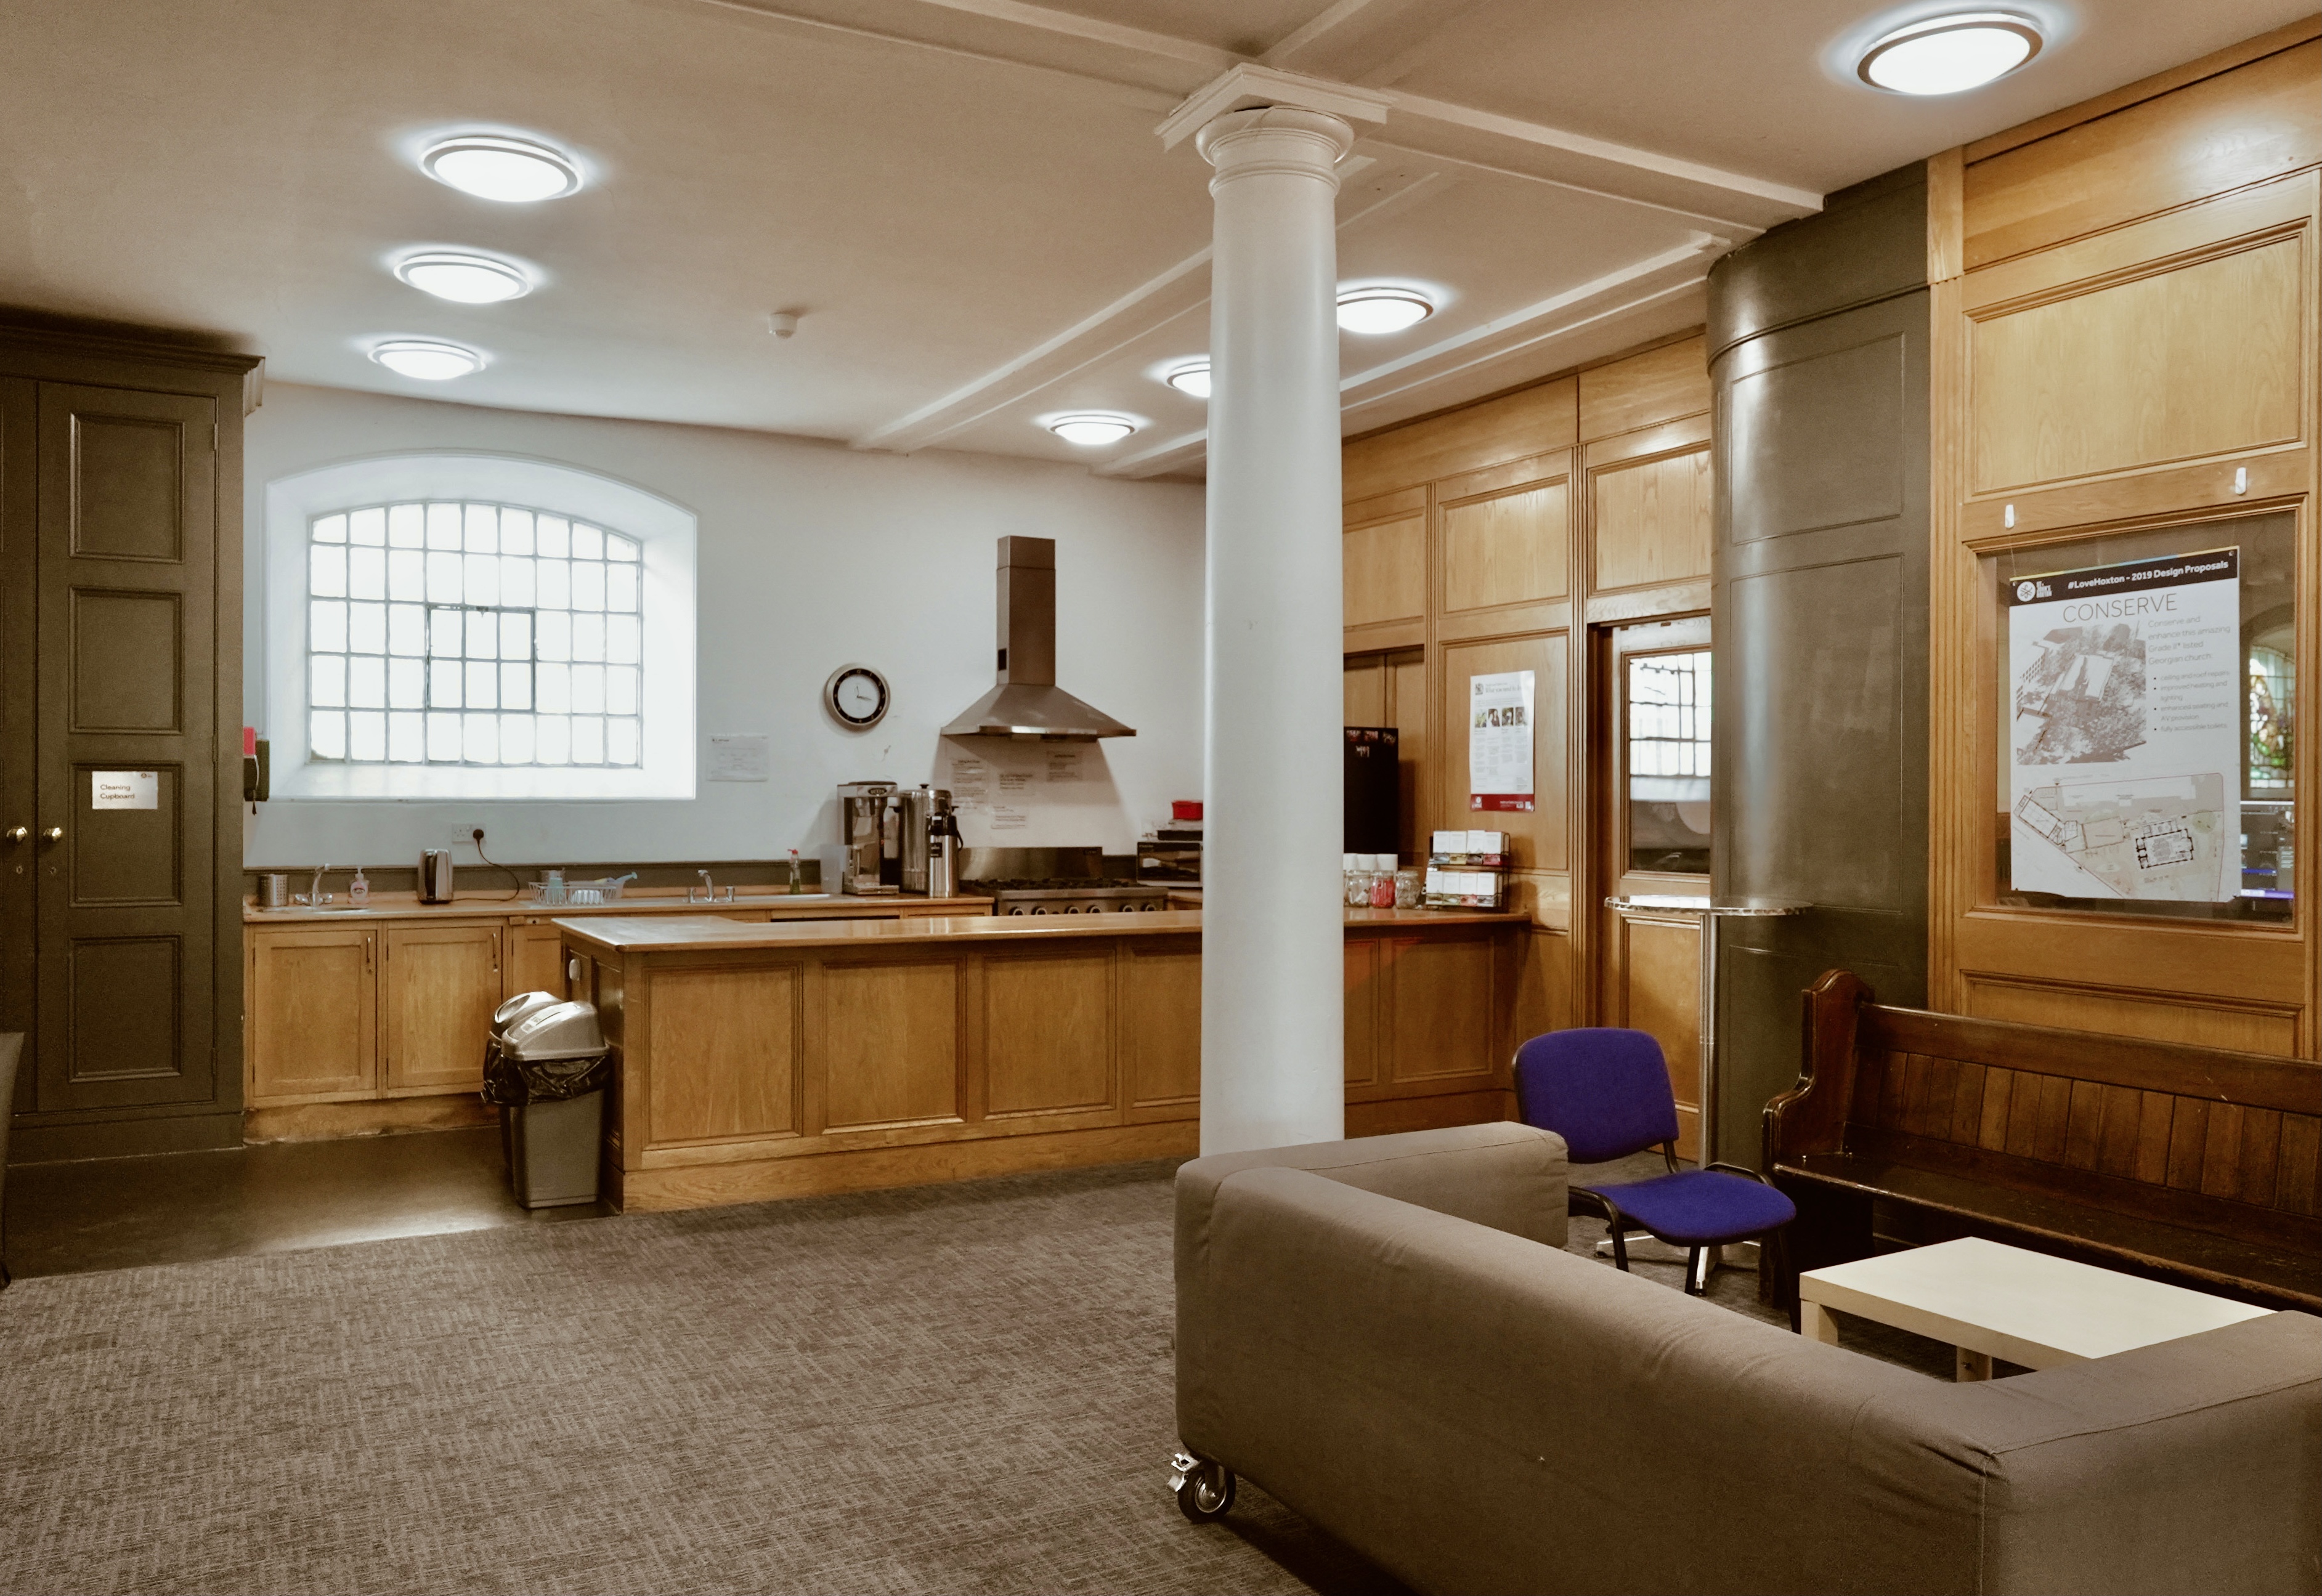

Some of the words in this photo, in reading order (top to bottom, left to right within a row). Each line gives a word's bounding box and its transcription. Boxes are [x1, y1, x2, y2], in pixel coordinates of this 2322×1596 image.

[2068, 576, 2125, 589] #LoveHoxton
[2132, 571, 2153, 581] 2019
[2153, 567, 2184, 577] Design
[2185, 561, 2229, 573] Proposals
[2063, 593, 2177, 623] CONSERVE
[2148, 618, 2185, 628] Conserve
[2148, 631, 2181, 640] enhance
[2198, 626, 2230, 635] amazing
[2148, 656, 2183, 665] Georgian
